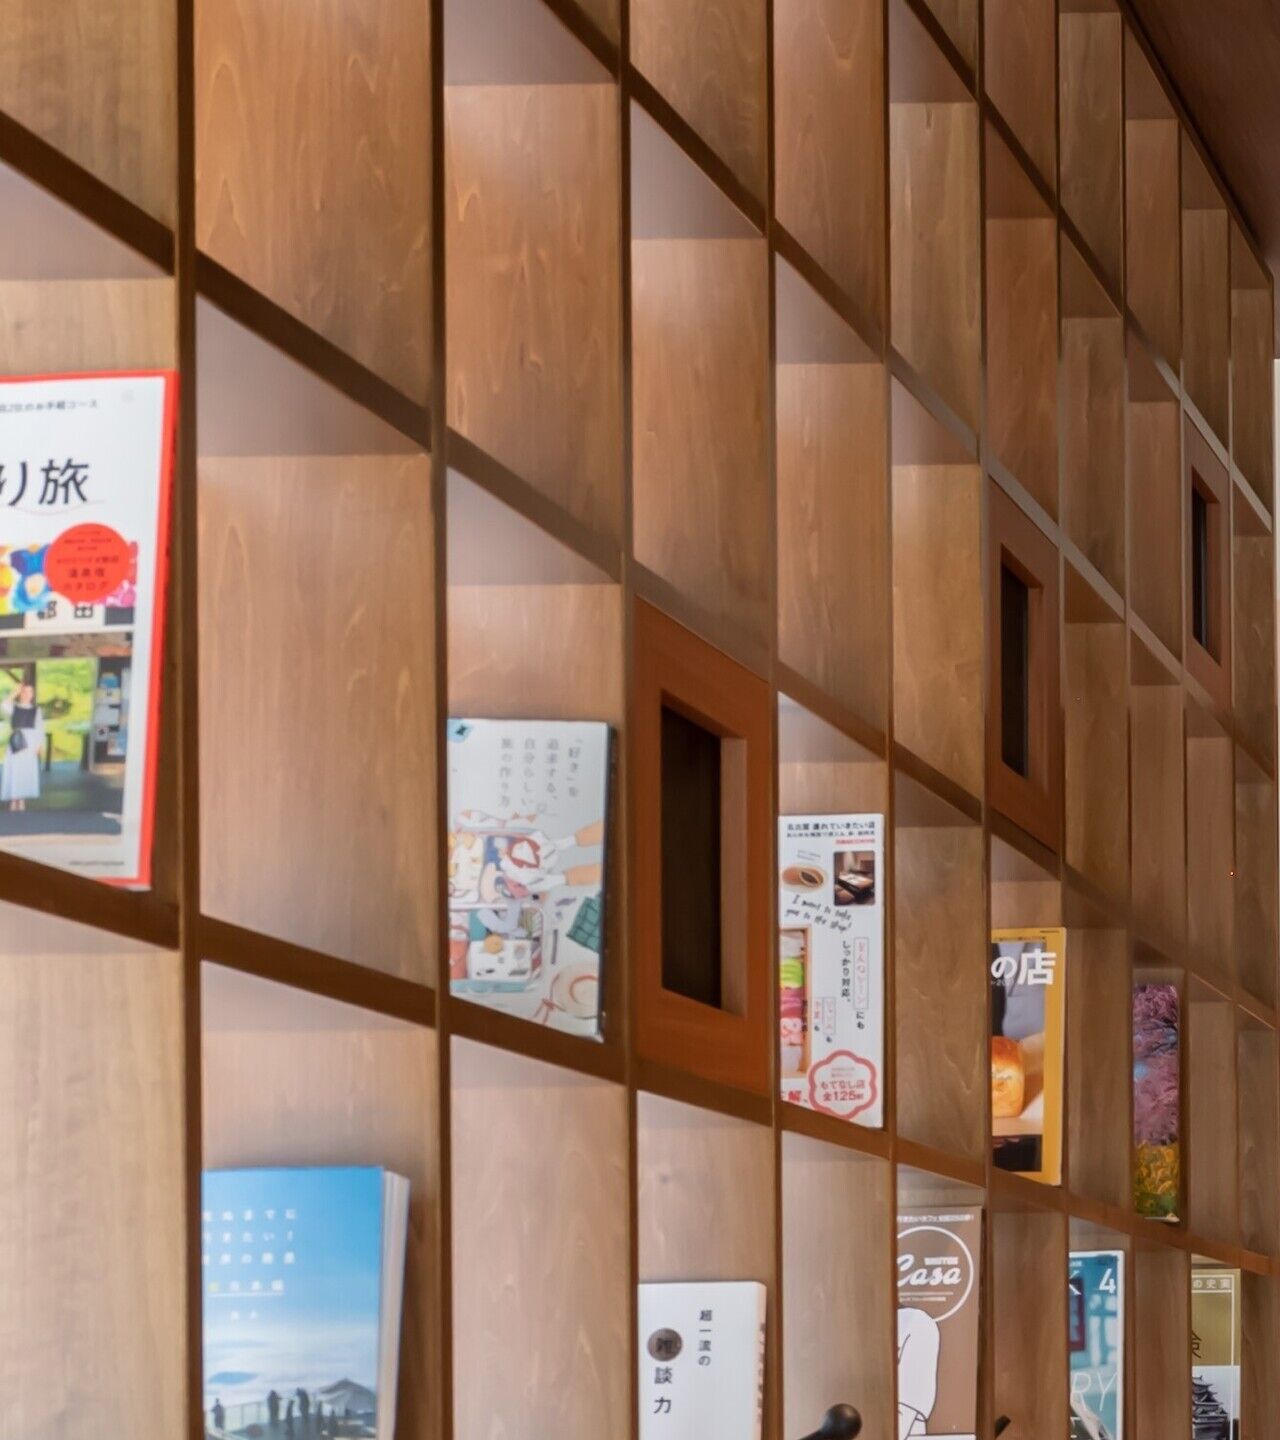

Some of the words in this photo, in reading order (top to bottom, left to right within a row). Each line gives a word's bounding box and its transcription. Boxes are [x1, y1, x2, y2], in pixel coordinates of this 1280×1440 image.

[991, 949, 1056, 986] の店
[1098, 1268, 1117, 1294] 4
[697, 1309, 713, 1367] 超一流の
